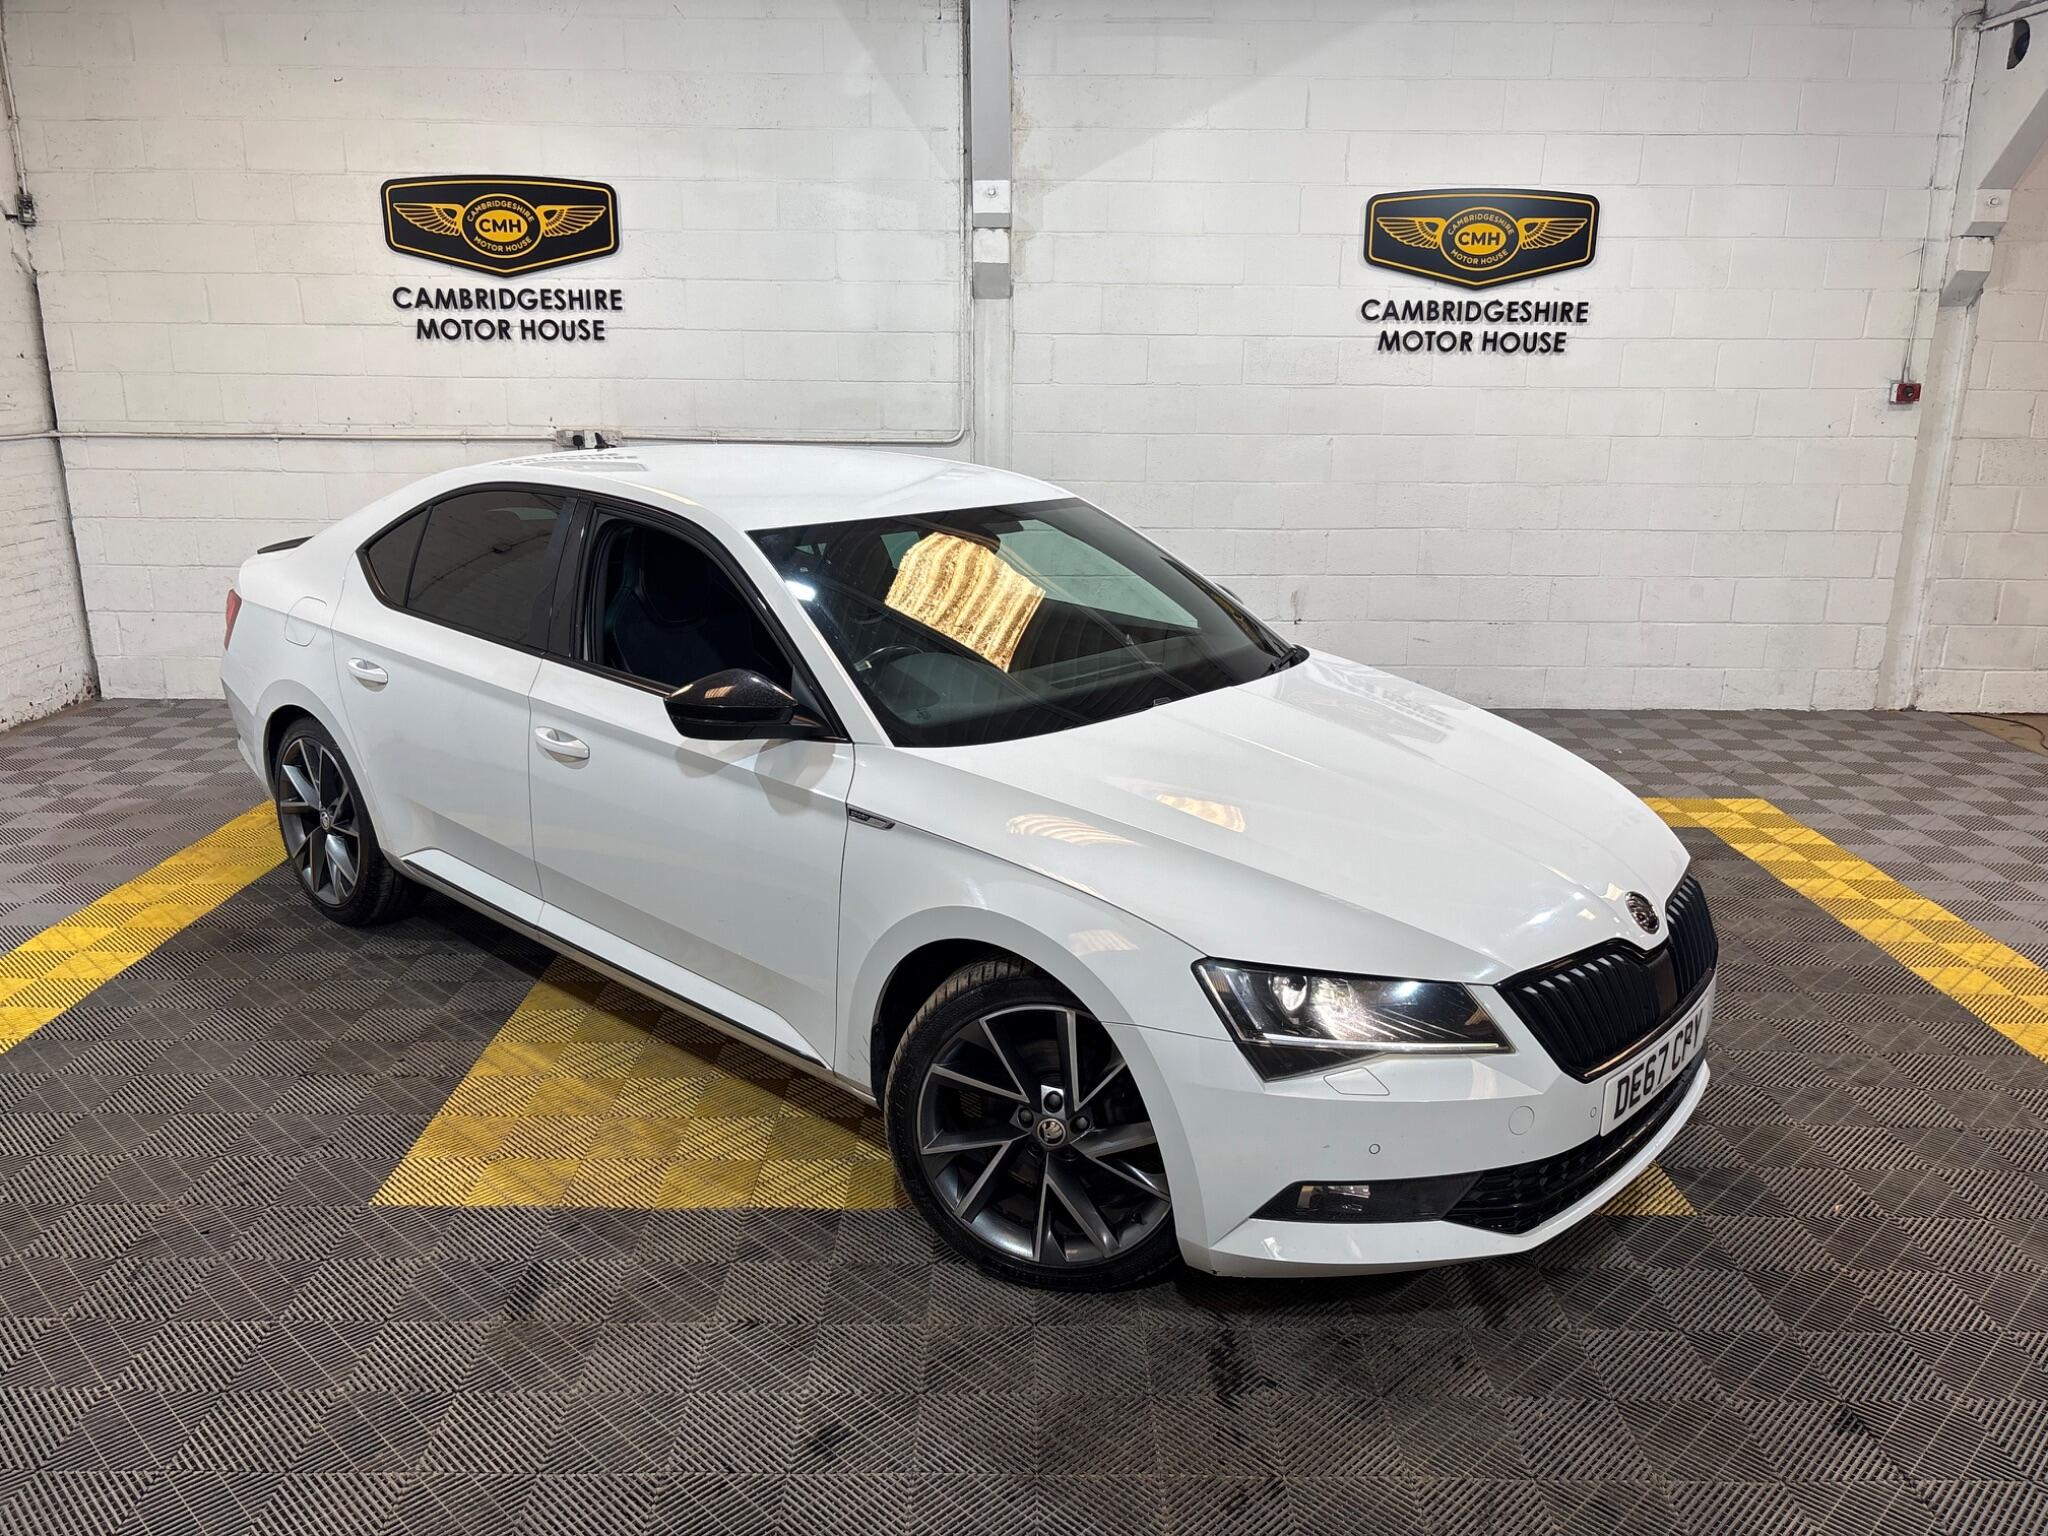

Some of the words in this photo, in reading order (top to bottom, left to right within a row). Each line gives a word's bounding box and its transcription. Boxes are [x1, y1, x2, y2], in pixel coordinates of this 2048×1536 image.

[467, 201, 534, 223] CAMBRIDGESHIRE
[479, 218, 522, 233] CMH
[1447, 213, 1514, 235] CAMBRIDGESHIRE
[473, 235, 504, 252] MOTOR
[505, 236, 533, 252] HOUSE
[1458, 231, 1501, 246] CMH
[1450, 248, 1479, 265] MOTOR
[1480, 248, 1509, 265] HOUSE
[392, 286, 622, 311] CAMBRIDGESHIRE
[1361, 299, 1589, 323] CAMBRIDGESHIRE
[417, 318, 511, 340] MOTOR
[520, 319, 606, 341] HOUSE
[1378, 330, 1473, 352] MOTOR
[1482, 331, 1567, 353] HOUSE
[1614, 1042, 1669, 1120] DE67
[1671, 1008, 1703, 1071] CRY
